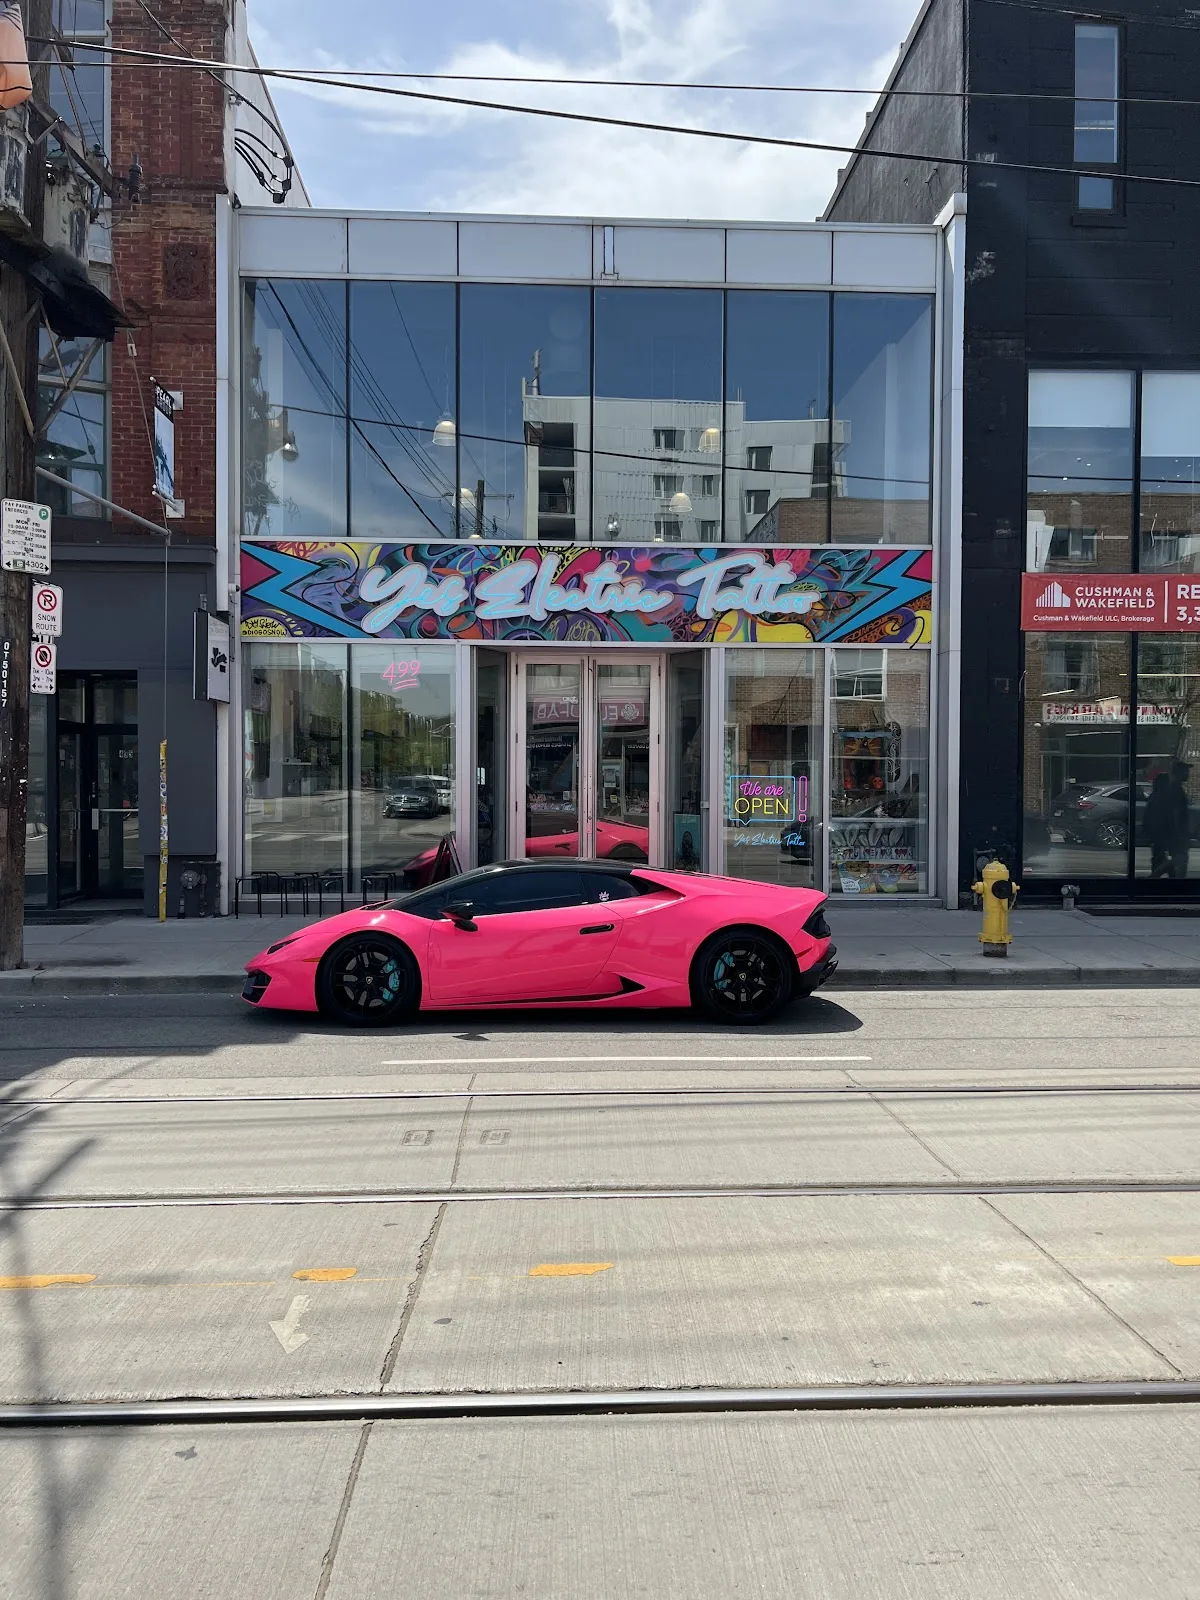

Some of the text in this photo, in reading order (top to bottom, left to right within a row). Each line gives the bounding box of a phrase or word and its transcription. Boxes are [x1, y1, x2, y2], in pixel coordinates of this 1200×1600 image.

[26, 560, 44, 569] 4302
[360, 552, 821, 633] Yes Electric Tattoo
[1075, 586, 1154, 597] CUSHMAN &
[1075, 598, 1155, 608] WAKEFIELD
[36, 623, 57, 631] ROUTE
[383, 660, 421, 681] 499
[740, 782, 784, 796] We are
[734, 798, 789, 814] OPEN
[734, 833, 805, 847] Yes Electric Tattoo
